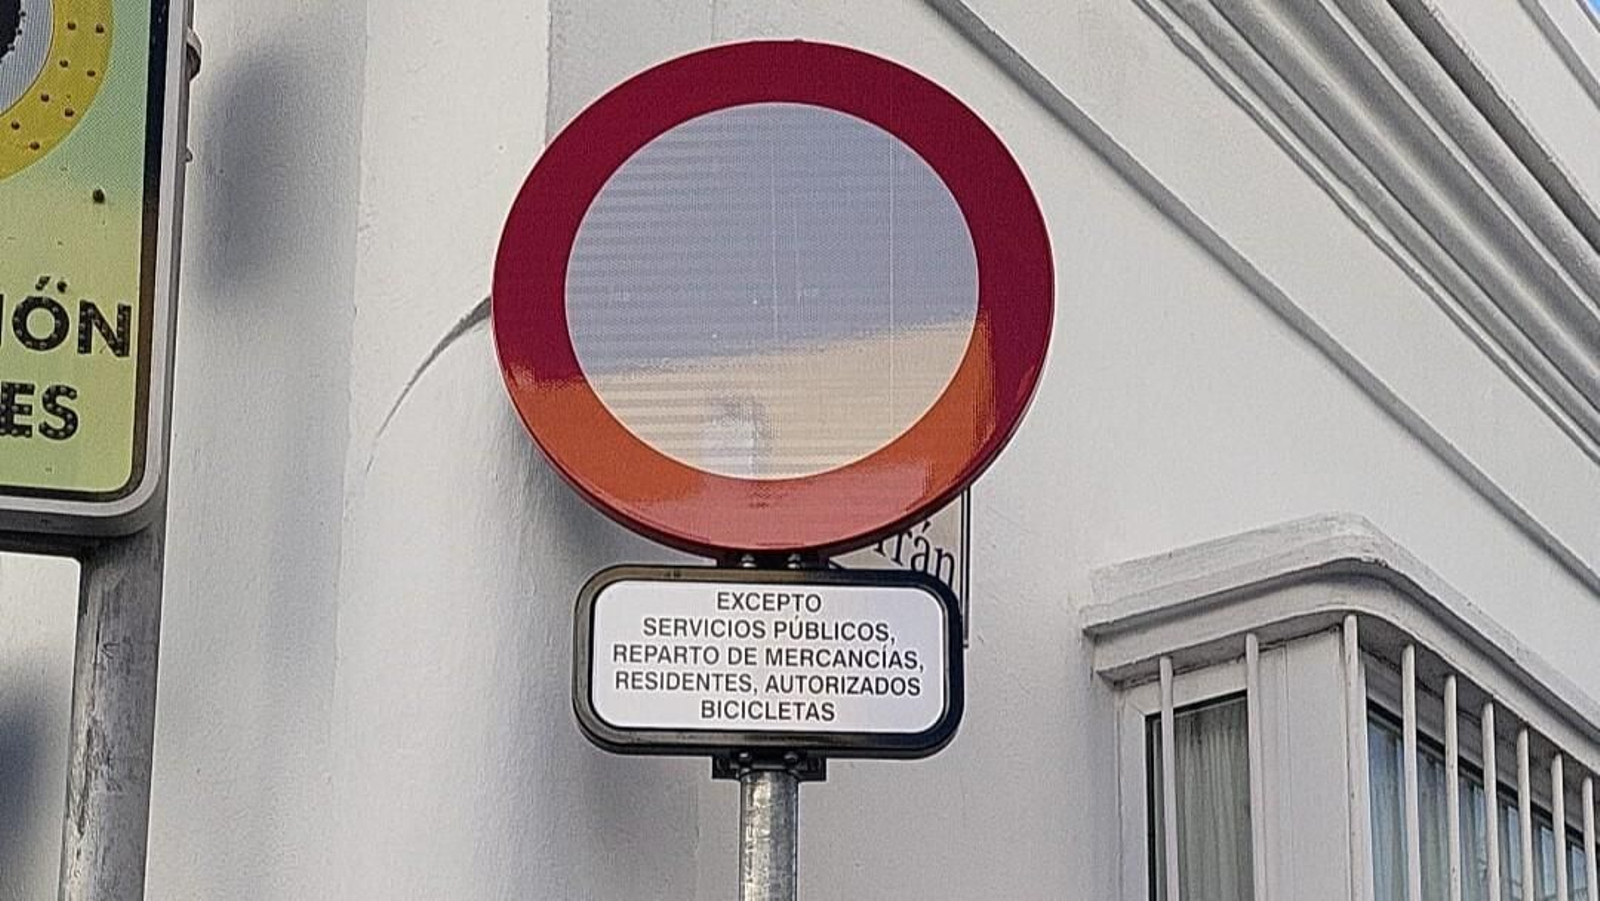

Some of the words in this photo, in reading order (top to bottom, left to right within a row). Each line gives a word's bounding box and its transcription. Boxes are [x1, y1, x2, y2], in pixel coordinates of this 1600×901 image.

[0, 275, 132, 357] ÓN
[717, 591, 822, 613] EXCEPTO
[643, 617, 766, 639] SERVICIOS
[774, 615, 896, 645] PÚBLICOS,
[613, 644, 720, 665] REPARTO
[728, 647, 757, 666] DE
[765, 643, 924, 673] MERCANCÍAS,
[615, 671, 758, 694] RESIDENTES,
[765, 674, 921, 697] AUTORIZADOS
[701, 700, 835, 722] BICICLETAS
